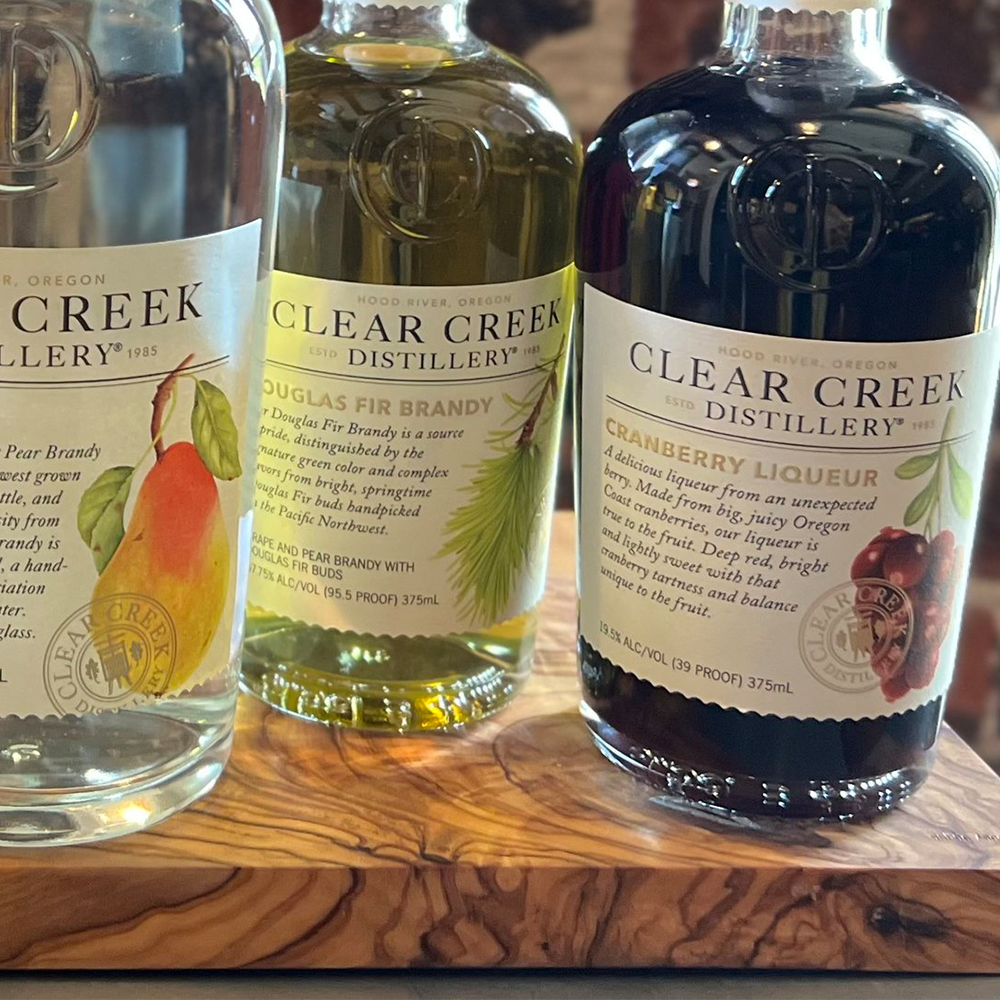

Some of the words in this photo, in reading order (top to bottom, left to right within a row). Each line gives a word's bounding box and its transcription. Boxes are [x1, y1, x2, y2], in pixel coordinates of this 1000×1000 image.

[28, 274, 105, 287] OREGON
[11, 281, 203, 334] CREEK
[357, 295, 400, 306] HOOD
[407, 298, 452, 308] RIVER,
[458, 295, 511, 307] OREGON
[272, 299, 425, 344] CLEAR
[444, 297, 562, 344] CREEK
[127, 345, 158, 359] 1985
[717, 345, 765, 361] HOOD
[833, 359, 898, 370] OREGON
[629, 341, 791, 404] CLEAR
[814, 369, 967, 409] CREEK
[264, 379, 347, 412] OUGLAS
[355, 396, 391, 415] FIR
[399, 397, 494, 417] BRANDY
[664, 394, 695, 411] ESTD
[271, 406, 318, 430] Douglas
[321, 417, 345, 433] Fir
[347, 422, 398, 442] Brandy
[401, 427, 412, 439] is
[414, 431, 423, 439] a
[426, 429, 465, 439] source
[4, 444, 42, 460] Pear
[45, 443, 102, 462] Brandy
[605, 417, 746, 475] CRANBERRY
[754, 461, 878, 487] LIQUEUR
[33, 470, 81, 486] grown
[604, 444, 613, 458] A
[614, 449, 663, 479] delicious
[666, 468, 719, 490] liqueur
[716, 483, 760, 502] from
[764, 494, 786, 506] an
[791, 496, 878, 516] unexpected
[31, 490, 64, 505] and
[277, 540, 299, 557] AND
[302, 547, 331, 564] PEAR
[334, 555, 382, 571] BRANDY
[384, 561, 415, 573] WITH
[292, 559, 313, 573] FIR
[311, 565, 343, 580] BUDS
[277, 574, 320, 595] ALC/VOL
[323, 586, 352, 601] (95.5
[355, 590, 398, 606] PROOF)
[401, 594, 440, 606] 375mL
[53, 613, 98, 700] CLEAR
[106, 601, 169, 661] CREEK
[599, 620, 622, 644] 19.5%
[623, 636, 668, 666] ALC/VOL
[672, 656, 691, 673] (39
[695, 664, 743, 689] PROOF)
[747, 677, 794, 695] 375mL
